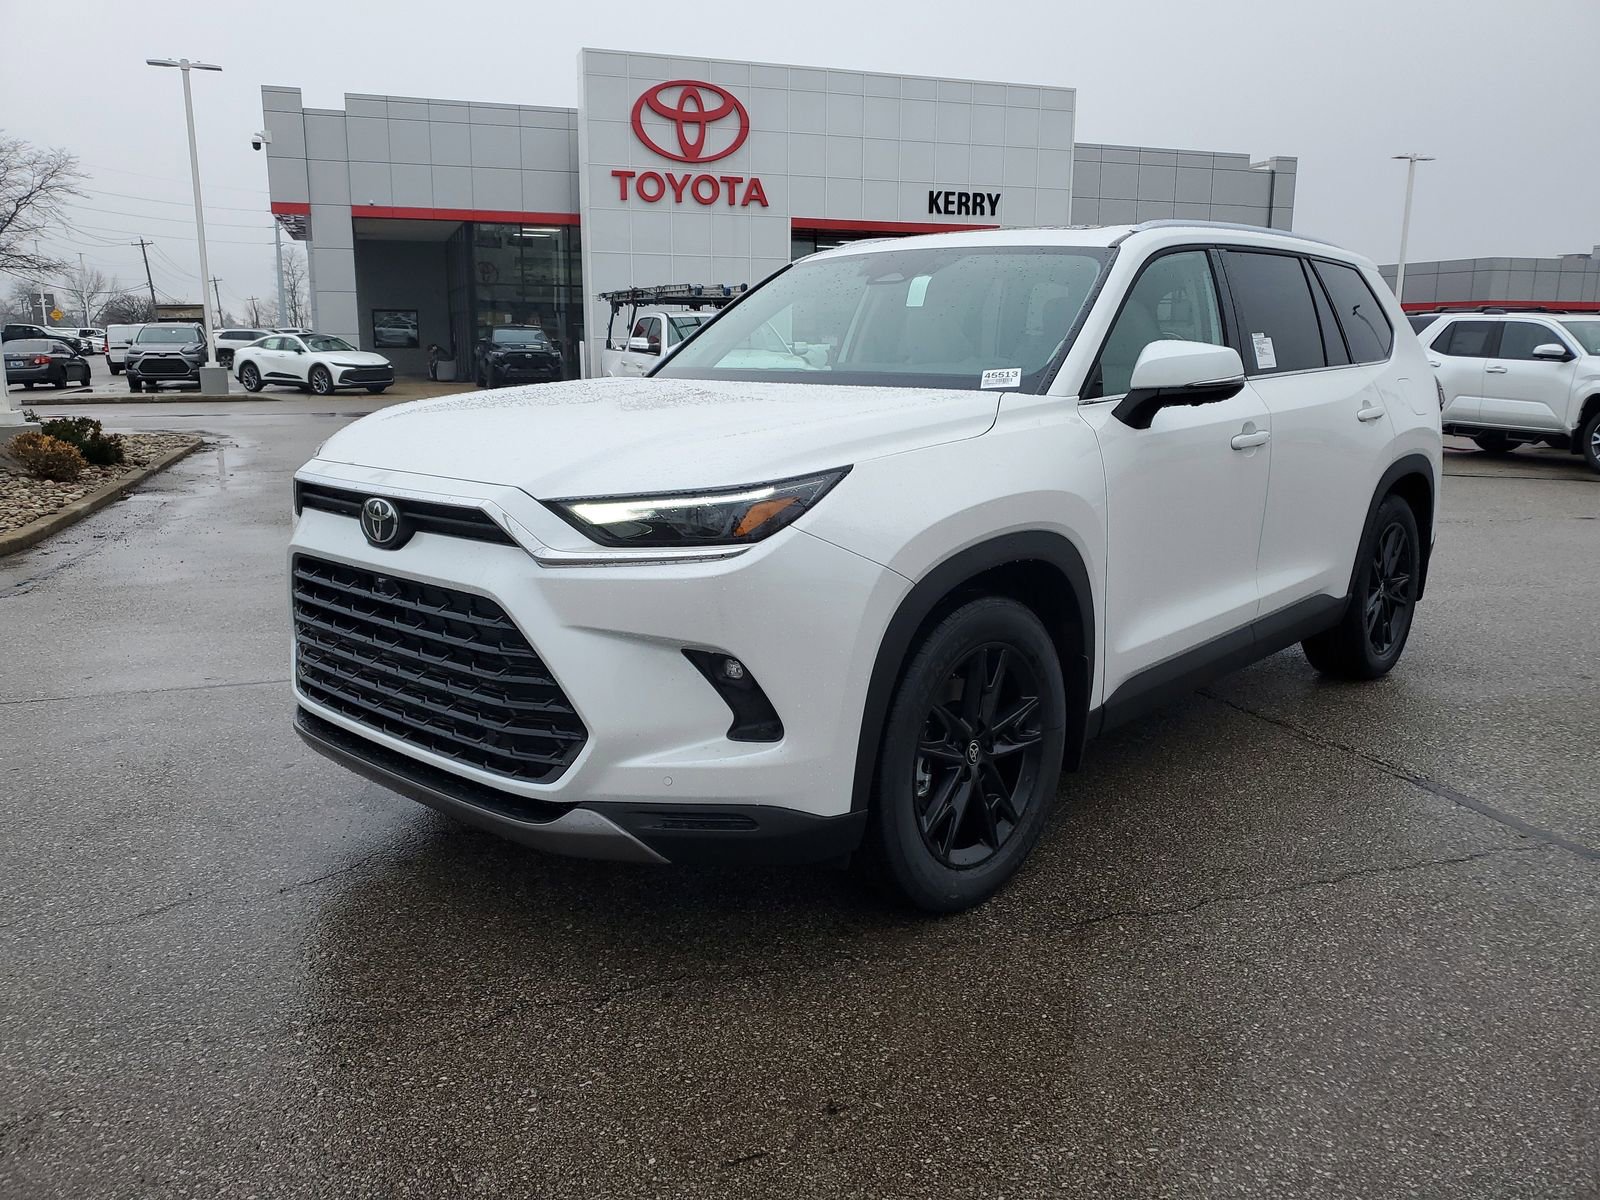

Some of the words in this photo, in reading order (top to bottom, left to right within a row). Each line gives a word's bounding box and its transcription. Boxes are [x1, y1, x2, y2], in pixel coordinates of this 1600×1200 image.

[611, 170, 769, 207] TOYOTA
[928, 190, 1001, 216] KERRY
[984, 371, 1018, 379] 45513
